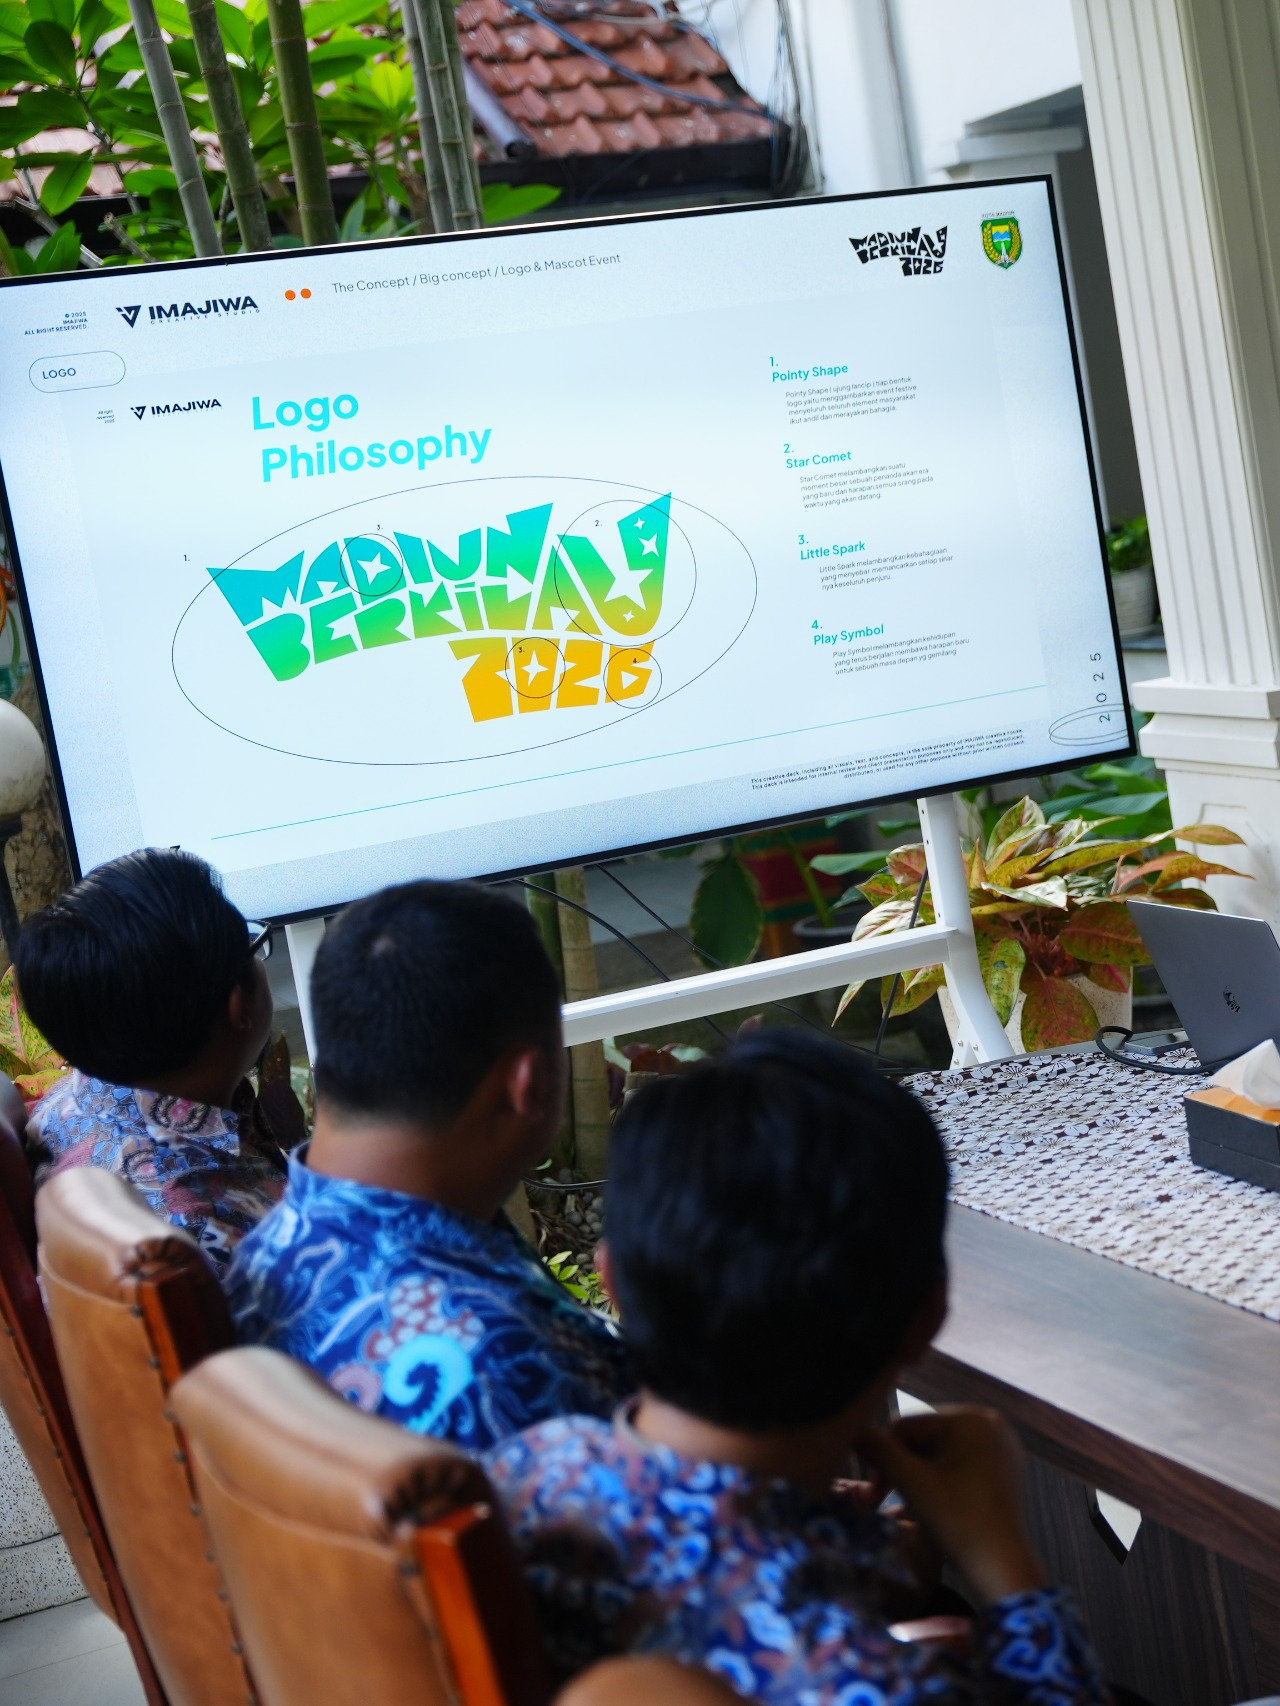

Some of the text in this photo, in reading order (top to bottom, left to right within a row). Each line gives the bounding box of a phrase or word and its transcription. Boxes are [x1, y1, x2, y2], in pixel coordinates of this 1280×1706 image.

[332, 254, 621, 294] The Concept / Big concept / Logo & Mascot Event
[148, 296, 258, 320] IMAJIWA
[770, 356, 778, 367] 1.
[42, 368, 76, 380] LOGO
[772, 364, 848, 382] Pointy Shape
[151, 398, 222, 415] IMAJIWA
[252, 394, 359, 432] Logo
[262, 424, 492, 482] Philosophy
[784, 443, 794, 453] 2.
[786, 451, 852, 468] Star Comet
[814, 472, 837, 481] Comet
[798, 534, 809, 544] 3.
[800, 541, 866, 560] Little Spark
[206, 502, 553, 626] MADIUN
[811, 620, 823, 630] 4.
[814, 624, 884, 645] Play Symbol
[448, 636, 655, 722] 2026
